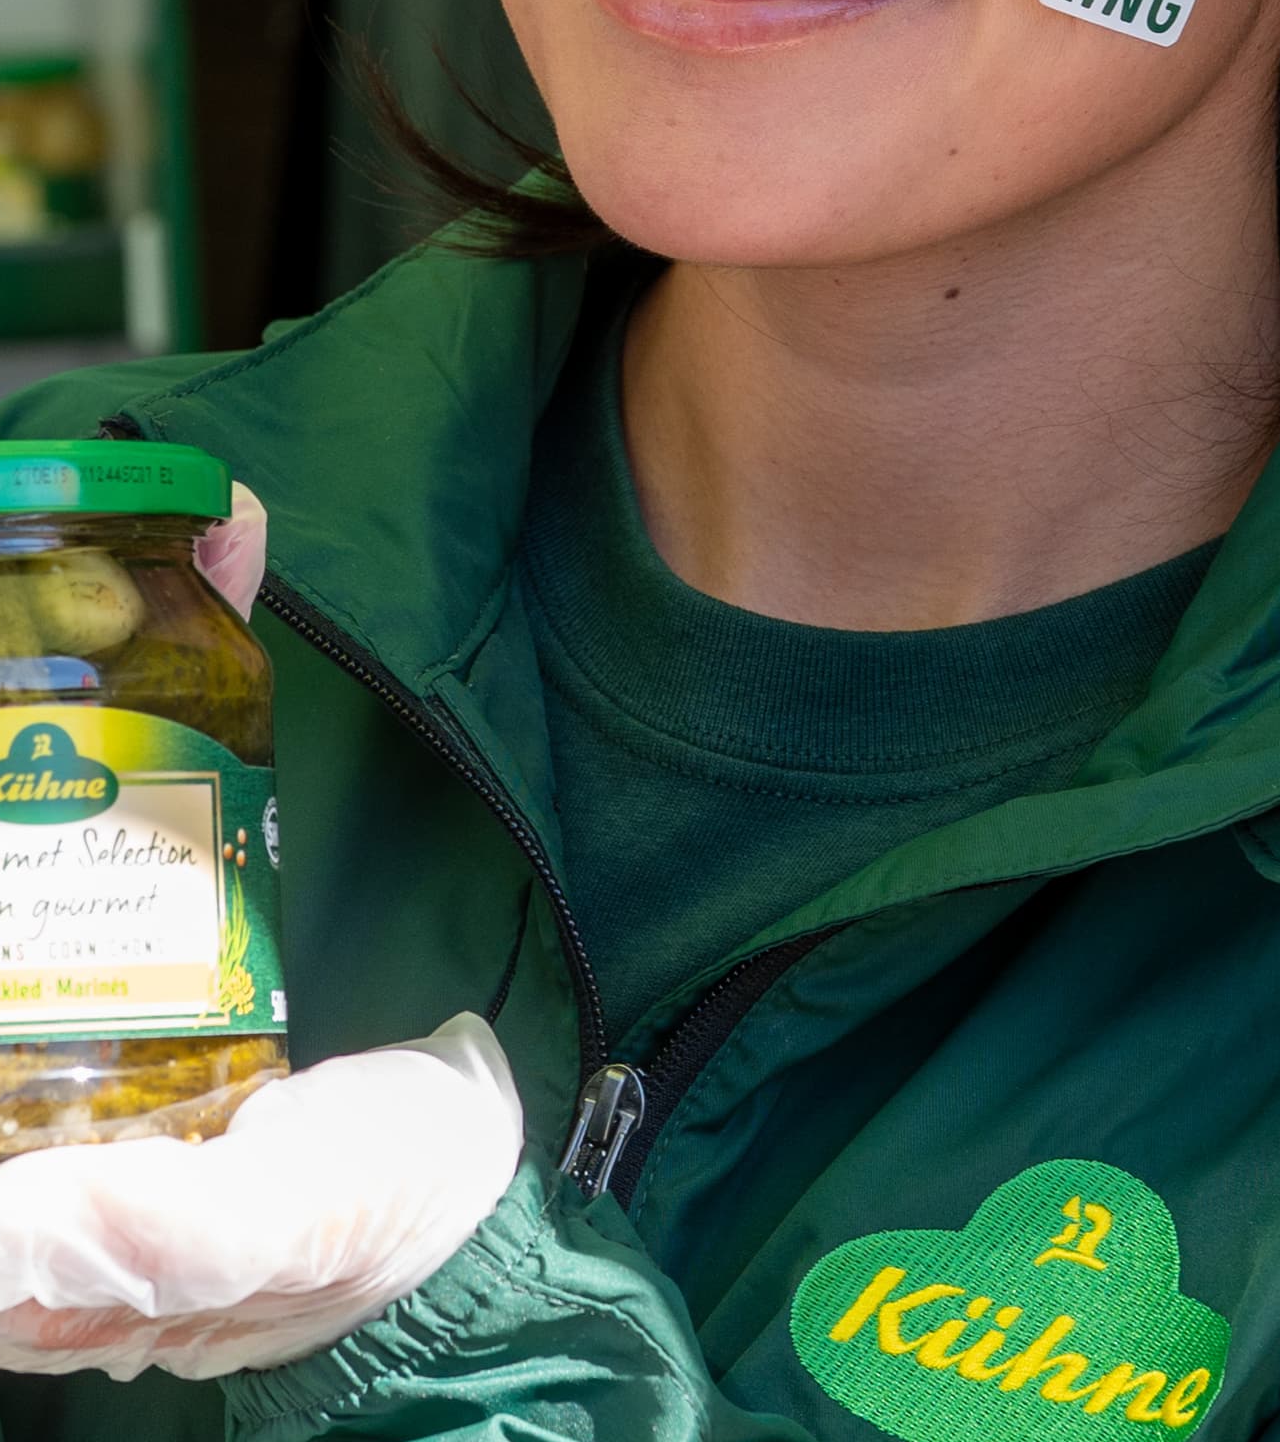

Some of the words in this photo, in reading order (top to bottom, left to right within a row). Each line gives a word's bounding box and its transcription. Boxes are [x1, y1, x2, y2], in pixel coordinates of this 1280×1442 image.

[78, 827, 198, 868] Selection
[27, 883, 157, 941] gourmet
[828, 1266, 1211, 1428] Kühne
